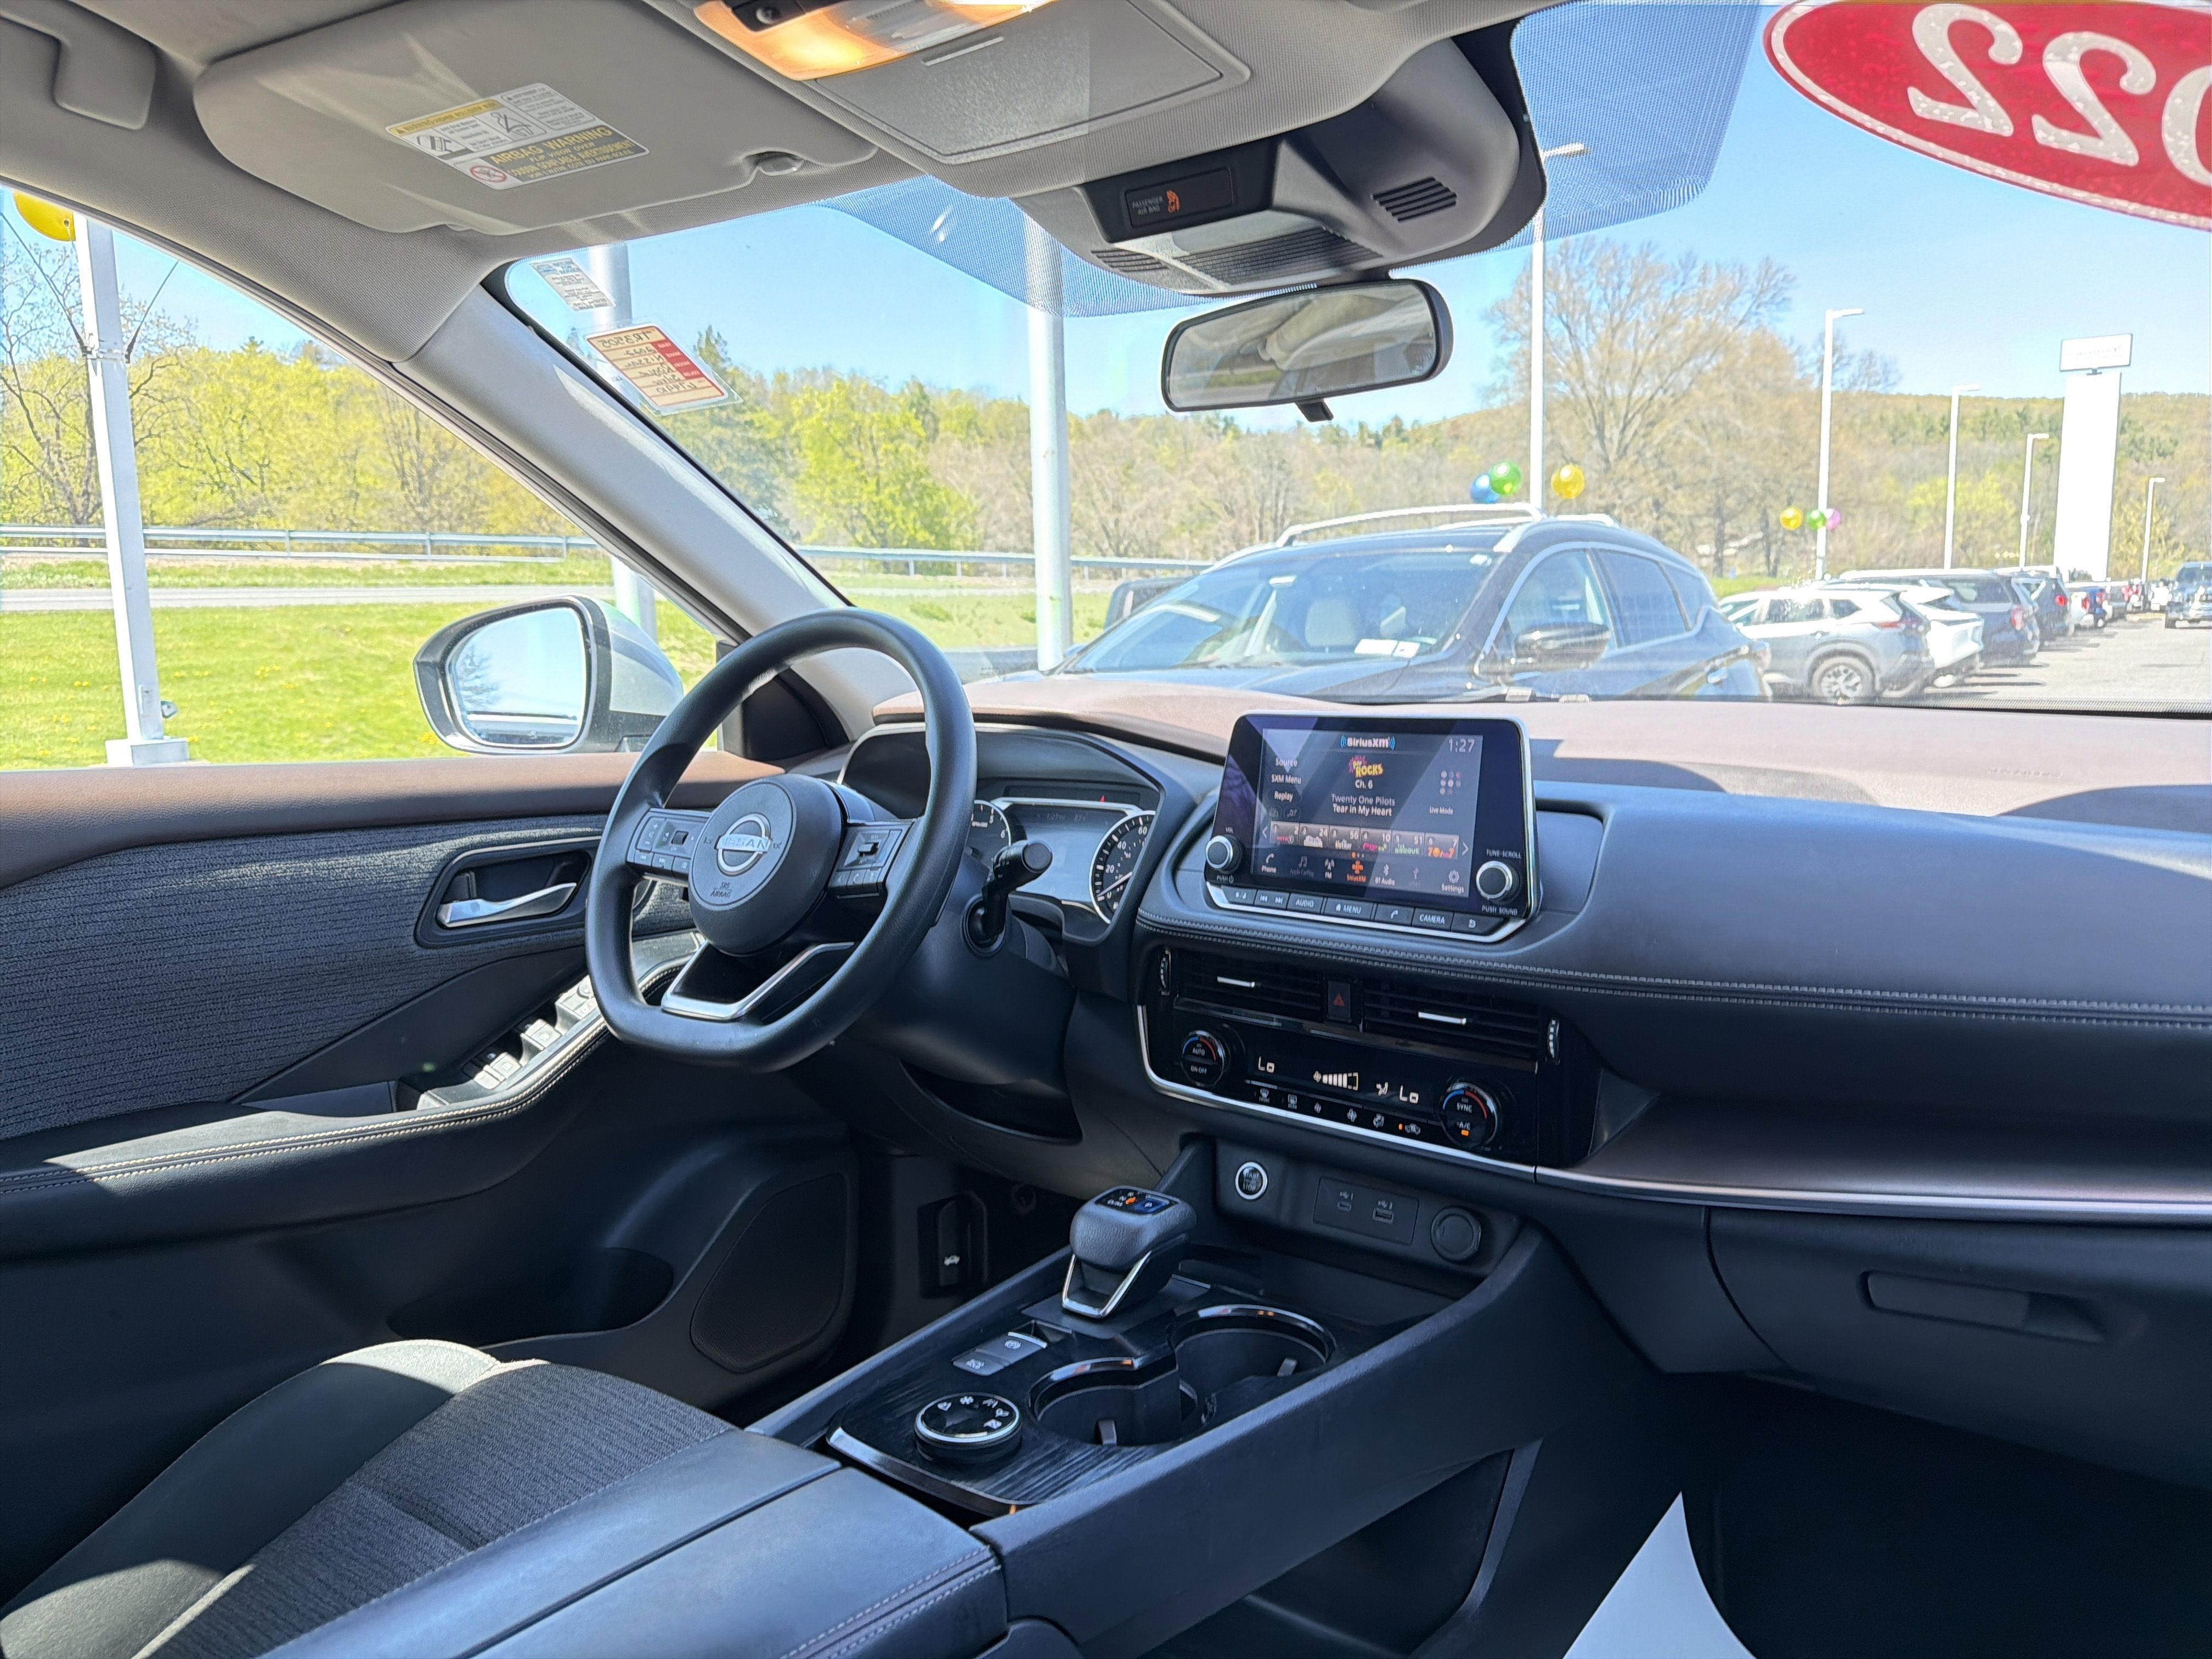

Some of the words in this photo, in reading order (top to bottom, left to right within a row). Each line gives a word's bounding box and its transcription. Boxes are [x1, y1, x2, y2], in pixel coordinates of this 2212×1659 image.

[491, 145, 544, 165] AIRBAG
[543, 127, 613, 149] WARNING
[529, 154, 545, 162] FLIP
[549, 148, 571, 157] VISOR
[573, 142, 596, 151] OVER
[1448, 738, 1475, 752] 1:27
[1276, 758, 1297, 767] Source
[1356, 764, 1383, 778] ROCKS
[1272, 774, 1284, 783] SXM
[1285, 775, 1302, 784] Menu
[1368, 780, 1373, 789] 6
[1274, 791, 1293, 803] Replay
[1331, 794, 1357, 806] Twenty
[1359, 795, 1373, 805] One
[1375, 796, 1395, 806] Pilots
[1333, 804, 1348, 813] Tear
[1358, 805, 1370, 816] My
[1371, 806, 1392, 816] Heart
[1440, 807, 1453, 815] Mode
[1001, 830, 1006, 838] 6
[1138, 826, 1147, 835] 60
[1319, 828, 1328, 837] 24
[1382, 833, 1391, 843] 10
[1414, 835, 1423, 845] 51
[1453, 838, 1457, 848] 7
[722, 837, 768, 850] NISSAN
[1118, 841, 1126, 850] 40
[1105, 864, 1114, 873] 20
[1262, 865, 1277, 873] Phone
[1381, 877, 1395, 886] Audio
[1441, 883, 1464, 894] Settings
[710, 890, 731, 898] AIRBAG
[1107, 890, 1111, 899] 0
[1295, 898, 1314, 908] AUDIO
[1343, 906, 1362, 915] MENU
[1482, 905, 1497, 913] PUSH
[1499, 906, 1518, 916] SOUND
[1419, 913, 1445, 925] CAMERA
[1192, 1047, 1205, 1057] AUTO
[1258, 1056, 1275, 1074] Lo
[1399, 1086, 1419, 1104] Lo
[1457, 1102, 1472, 1113] SYNC
[1458, 1121, 1471, 1131] A/C
